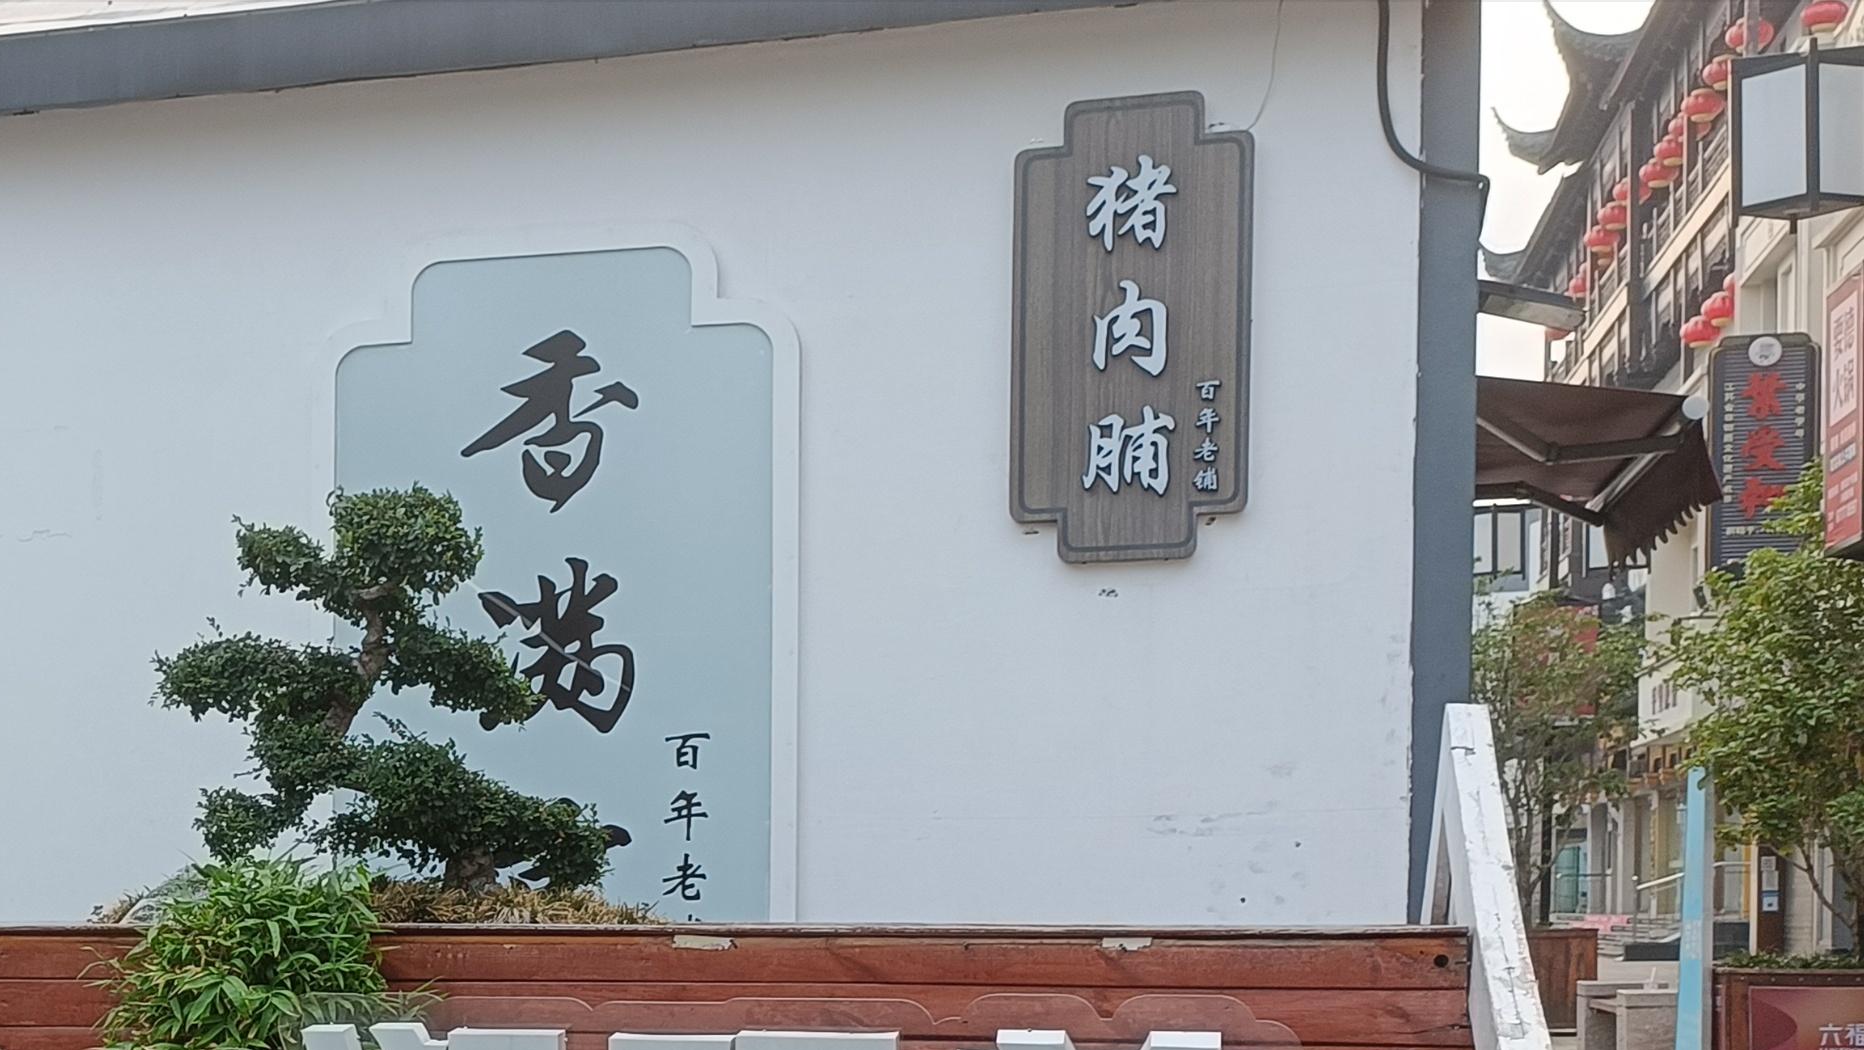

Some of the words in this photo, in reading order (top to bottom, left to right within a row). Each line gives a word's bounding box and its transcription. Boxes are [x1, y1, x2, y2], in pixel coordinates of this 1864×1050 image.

[1081, 154, 1178, 496] 猪肉脯
[1193, 379, 1222, 492] 百年老铺
[459, 329, 639, 891] 香满
[661, 732, 711, 922] 百年老
